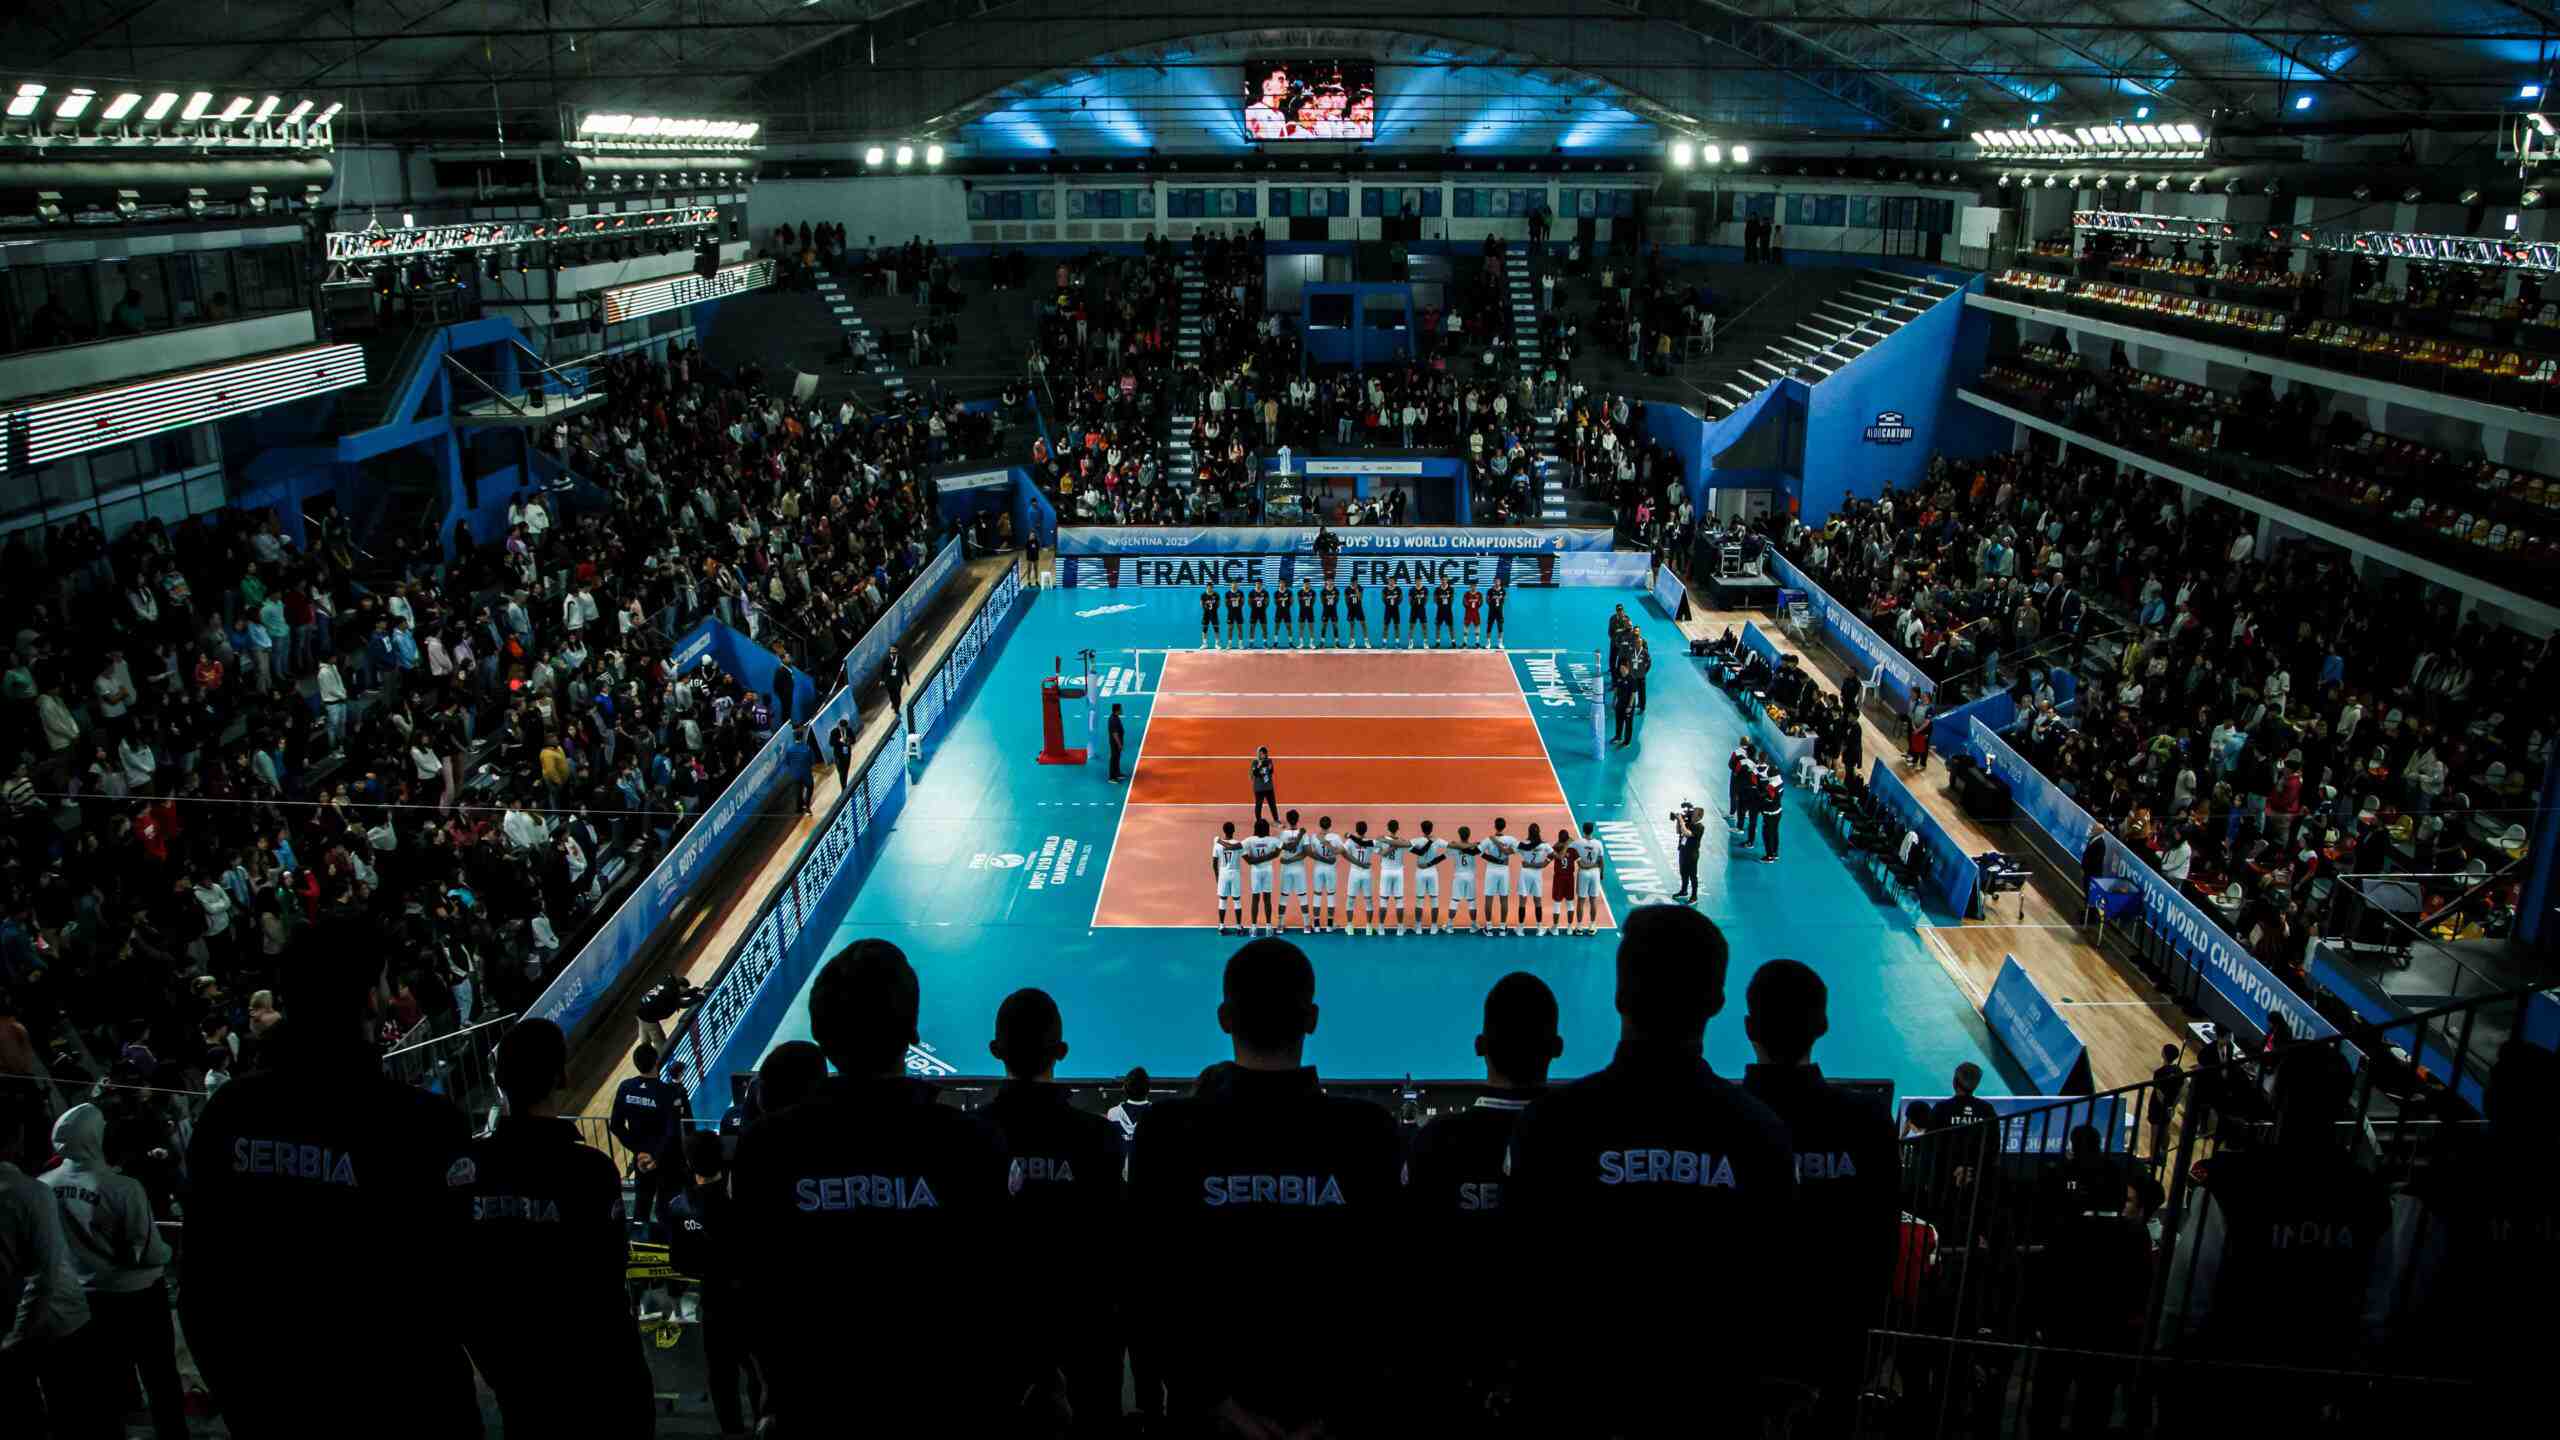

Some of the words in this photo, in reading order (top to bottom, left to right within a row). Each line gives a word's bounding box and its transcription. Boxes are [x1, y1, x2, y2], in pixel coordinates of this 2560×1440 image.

[1375, 535, 1400, 548] U19
[1404, 536, 1447, 548] WORLD
[1451, 537, 1546, 549] CHAMPIONSHIP
[1136, 559, 1263, 585] FRANCE
[1352, 559, 1479, 585] FRANCE
[1595, 820, 1650, 865] JUAN
[2166, 902, 2209, 954] WORLD
[2209, 942, 2318, 1040] CHAMPIONSHIP
[232, 1136, 359, 1189] SERBIA
[1599, 1148, 1738, 1190] SERBIA
[795, 1173, 941, 1212] SERBIA
[1202, 1172, 1347, 1208] SERBIA
